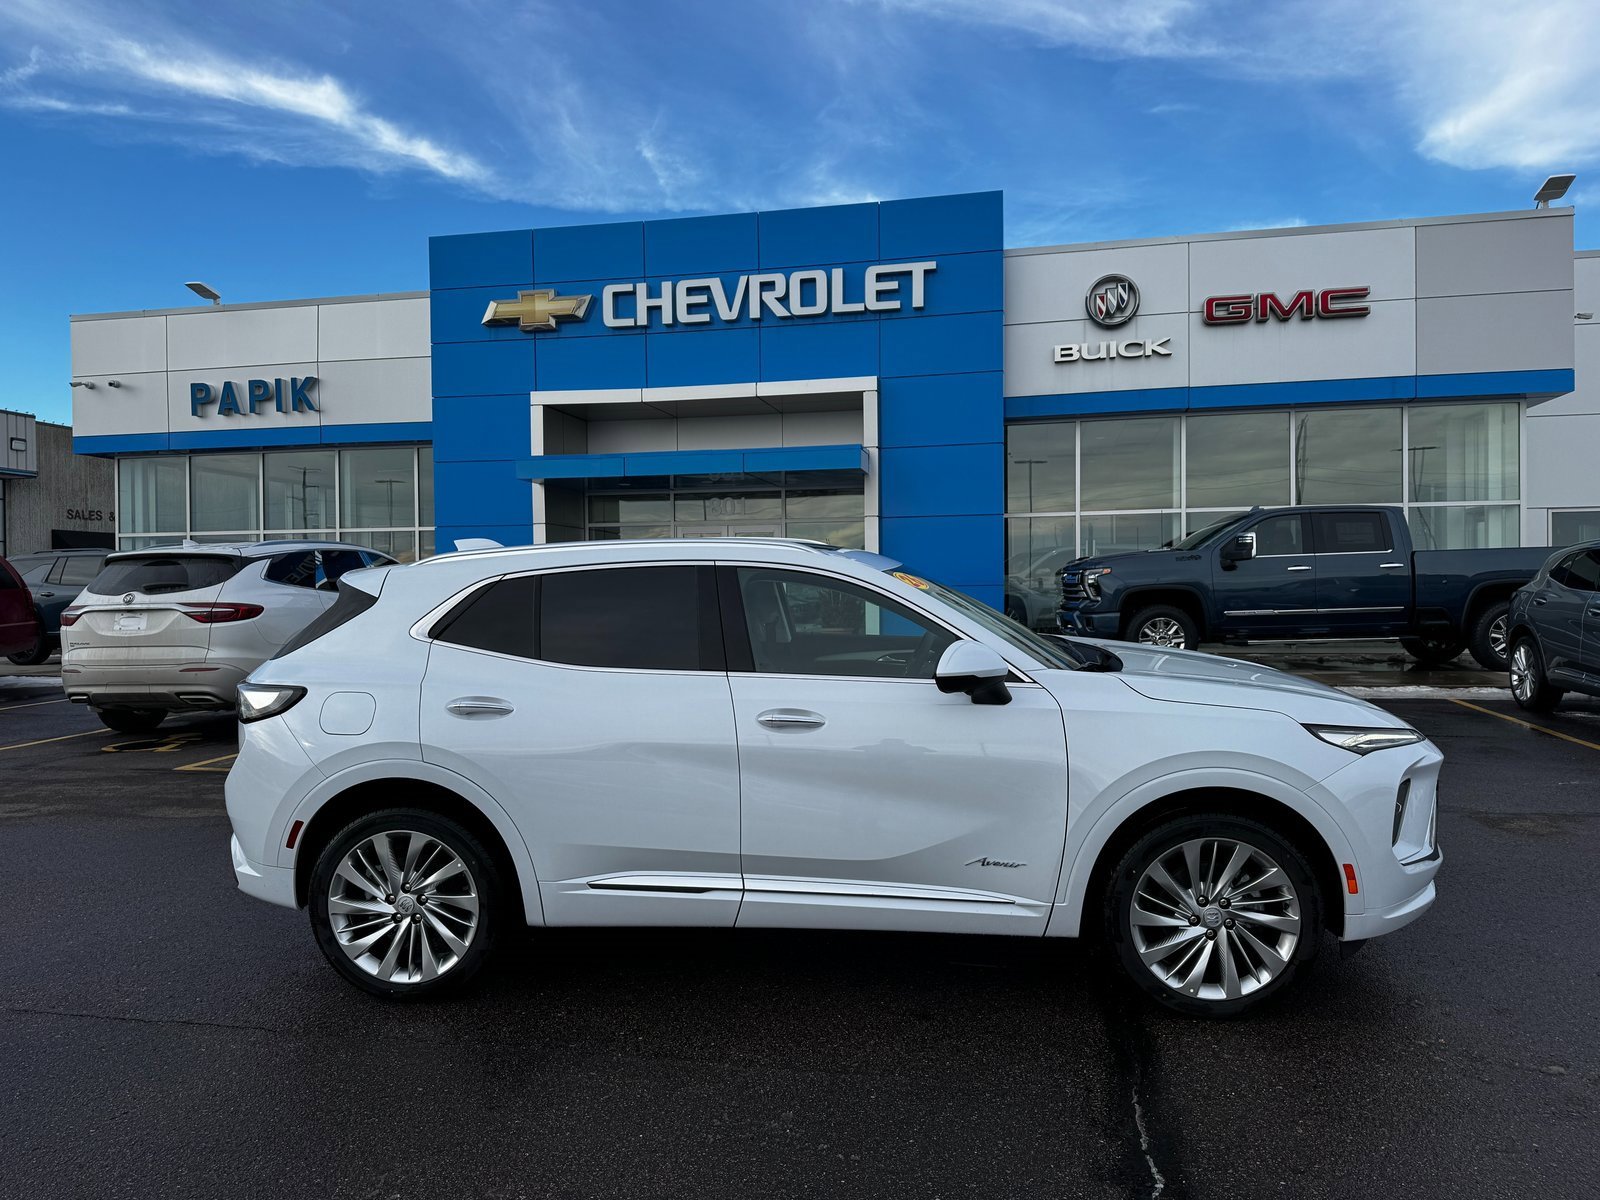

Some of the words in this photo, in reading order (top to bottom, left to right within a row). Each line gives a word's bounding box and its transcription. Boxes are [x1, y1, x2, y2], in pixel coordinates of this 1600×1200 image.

[602, 260, 938, 329] CHEVROLET
[1202, 285, 1371, 326] GMC
[1053, 336, 1173, 364] BUICK
[189, 375, 320, 418] PAPIK
[66, 508, 103, 521] SALES
[964, 856, 1027, 869] Avenir
